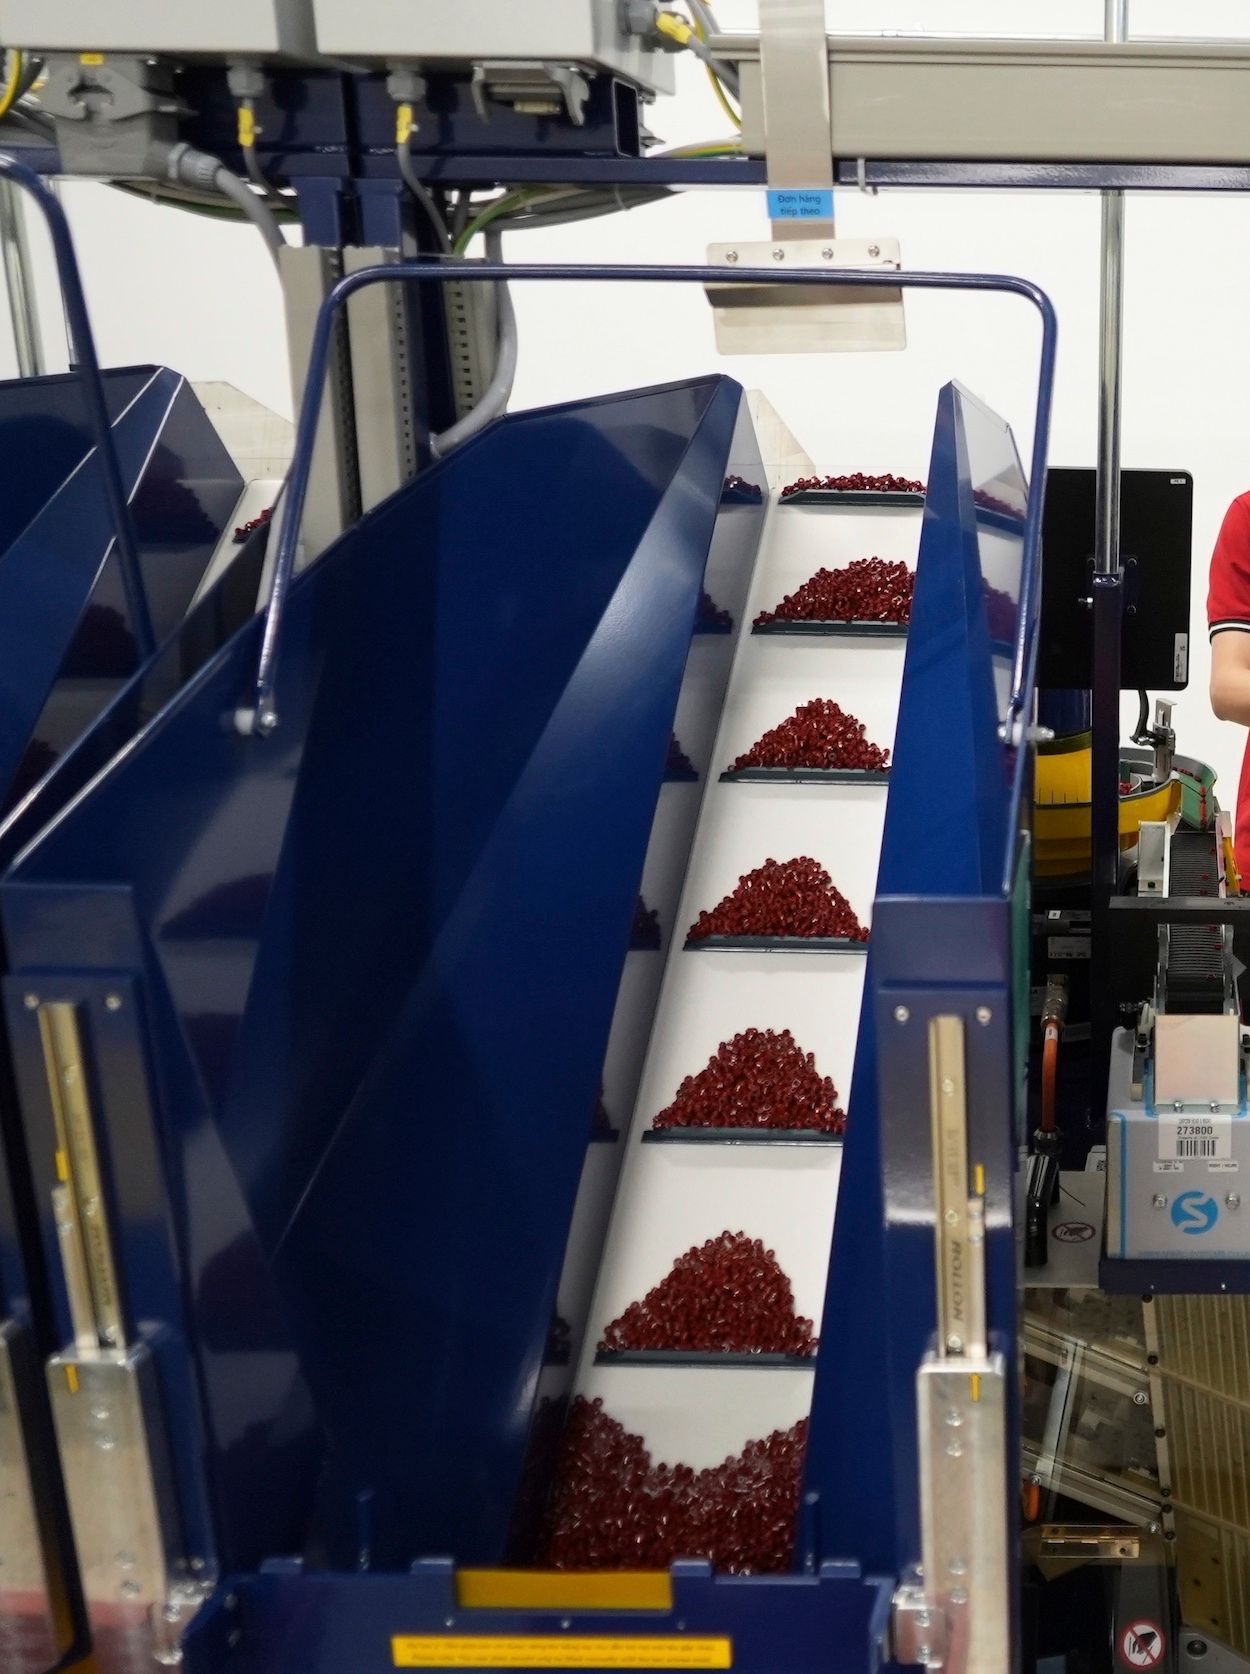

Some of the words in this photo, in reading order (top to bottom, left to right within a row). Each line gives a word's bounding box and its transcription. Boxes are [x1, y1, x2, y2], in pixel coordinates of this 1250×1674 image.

[778, 194, 796, 203] Đơn
[799, 193, 821, 205] hàng
[800, 207, 820, 215] theo
[1177, 1126, 1213, 1135] 273800
[952, 1241, 963, 1321] ROLLON
